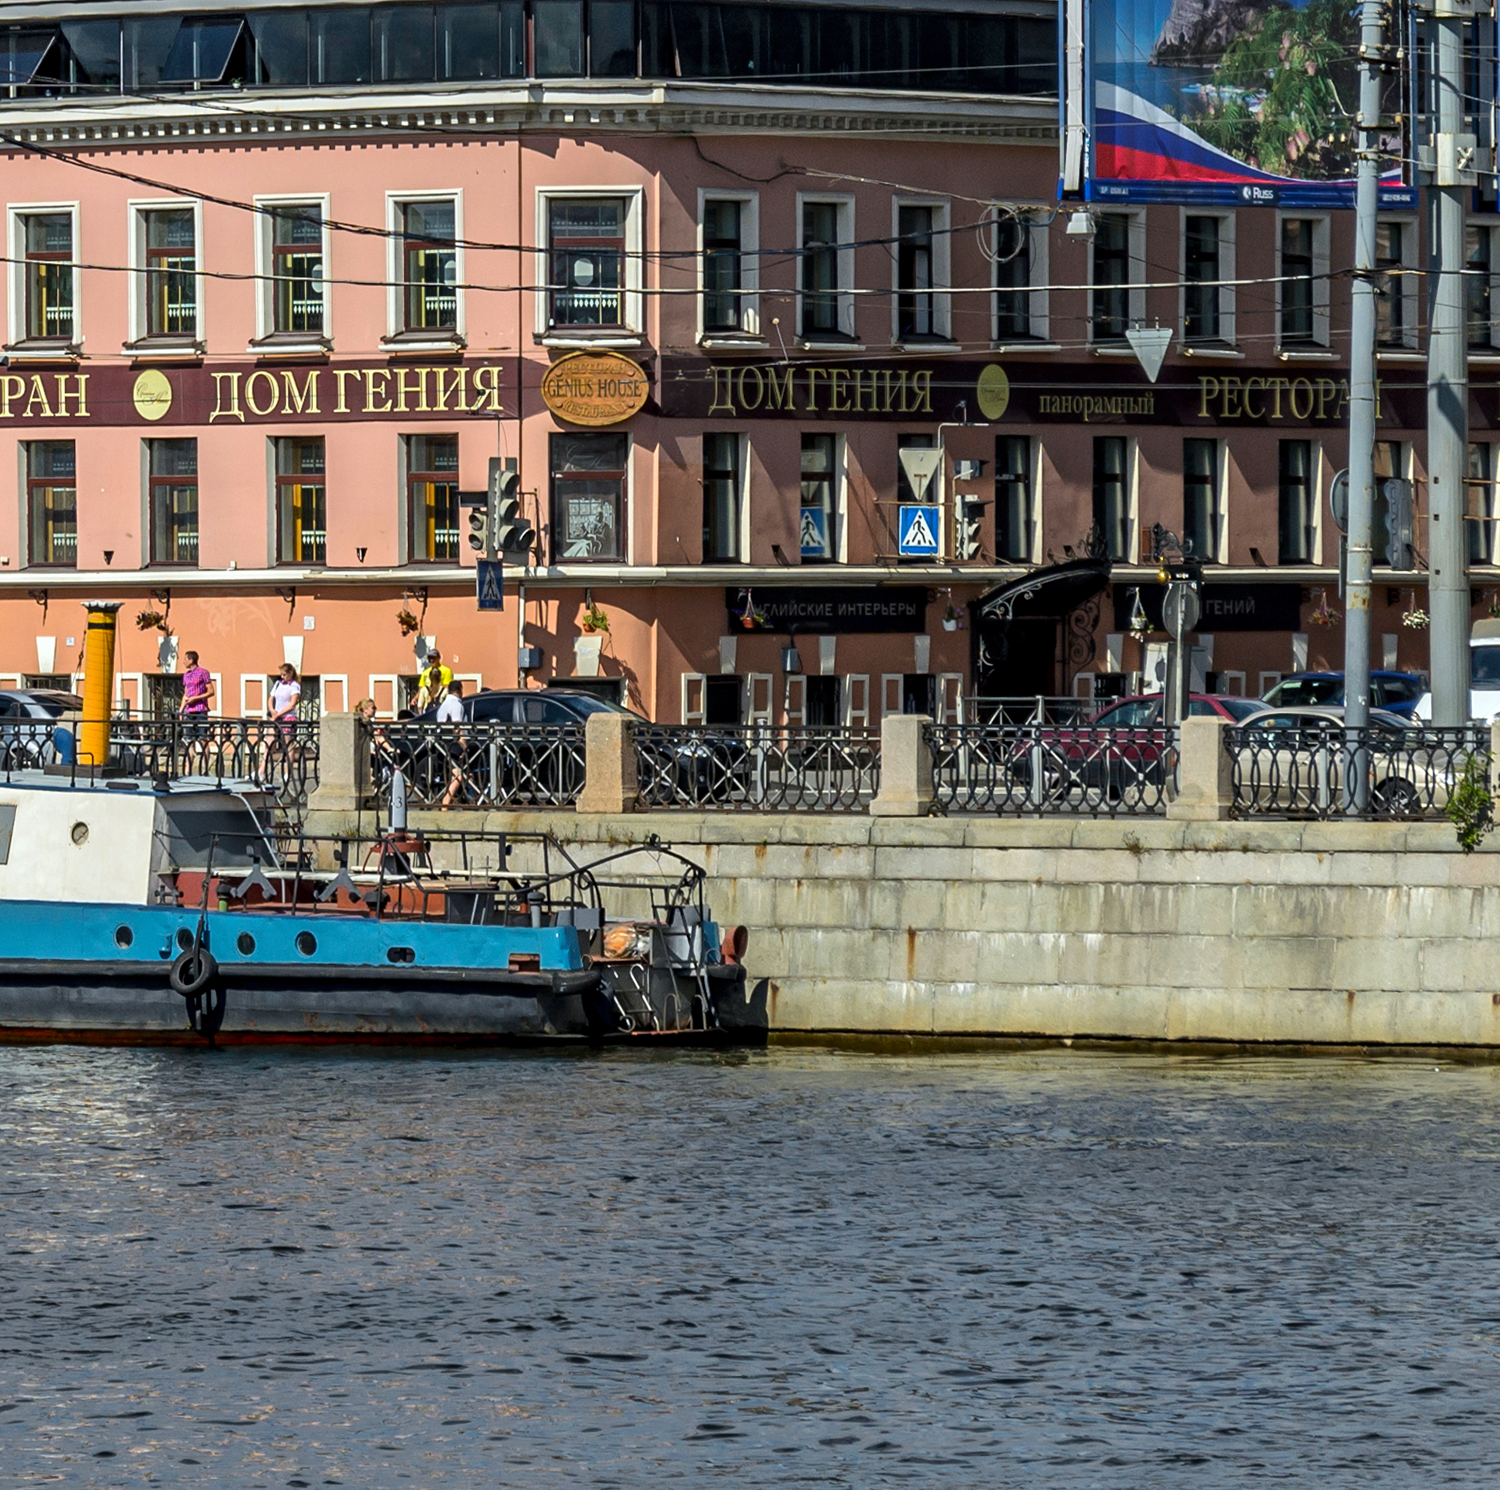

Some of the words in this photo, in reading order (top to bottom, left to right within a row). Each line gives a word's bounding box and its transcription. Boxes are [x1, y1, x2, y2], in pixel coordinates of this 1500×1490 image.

[209, 370, 322, 423] ДОМ
[332, 367, 504, 413] ГЕНИЯ
[548, 378, 593, 397] GENIUS
[597, 378, 642, 398] HOUSE
[708, 366, 796, 416] ДОМ
[806, 368, 934, 412] ГЕНИЯ
[1039, 392, 1155, 422] панорамный
[753, 598, 833, 617] НГЛИЙСКИЕ
[838, 603, 916, 616] ИНТЕРЬЕРЫ
[1206, 596, 1256, 615] ГЕНИЙ
